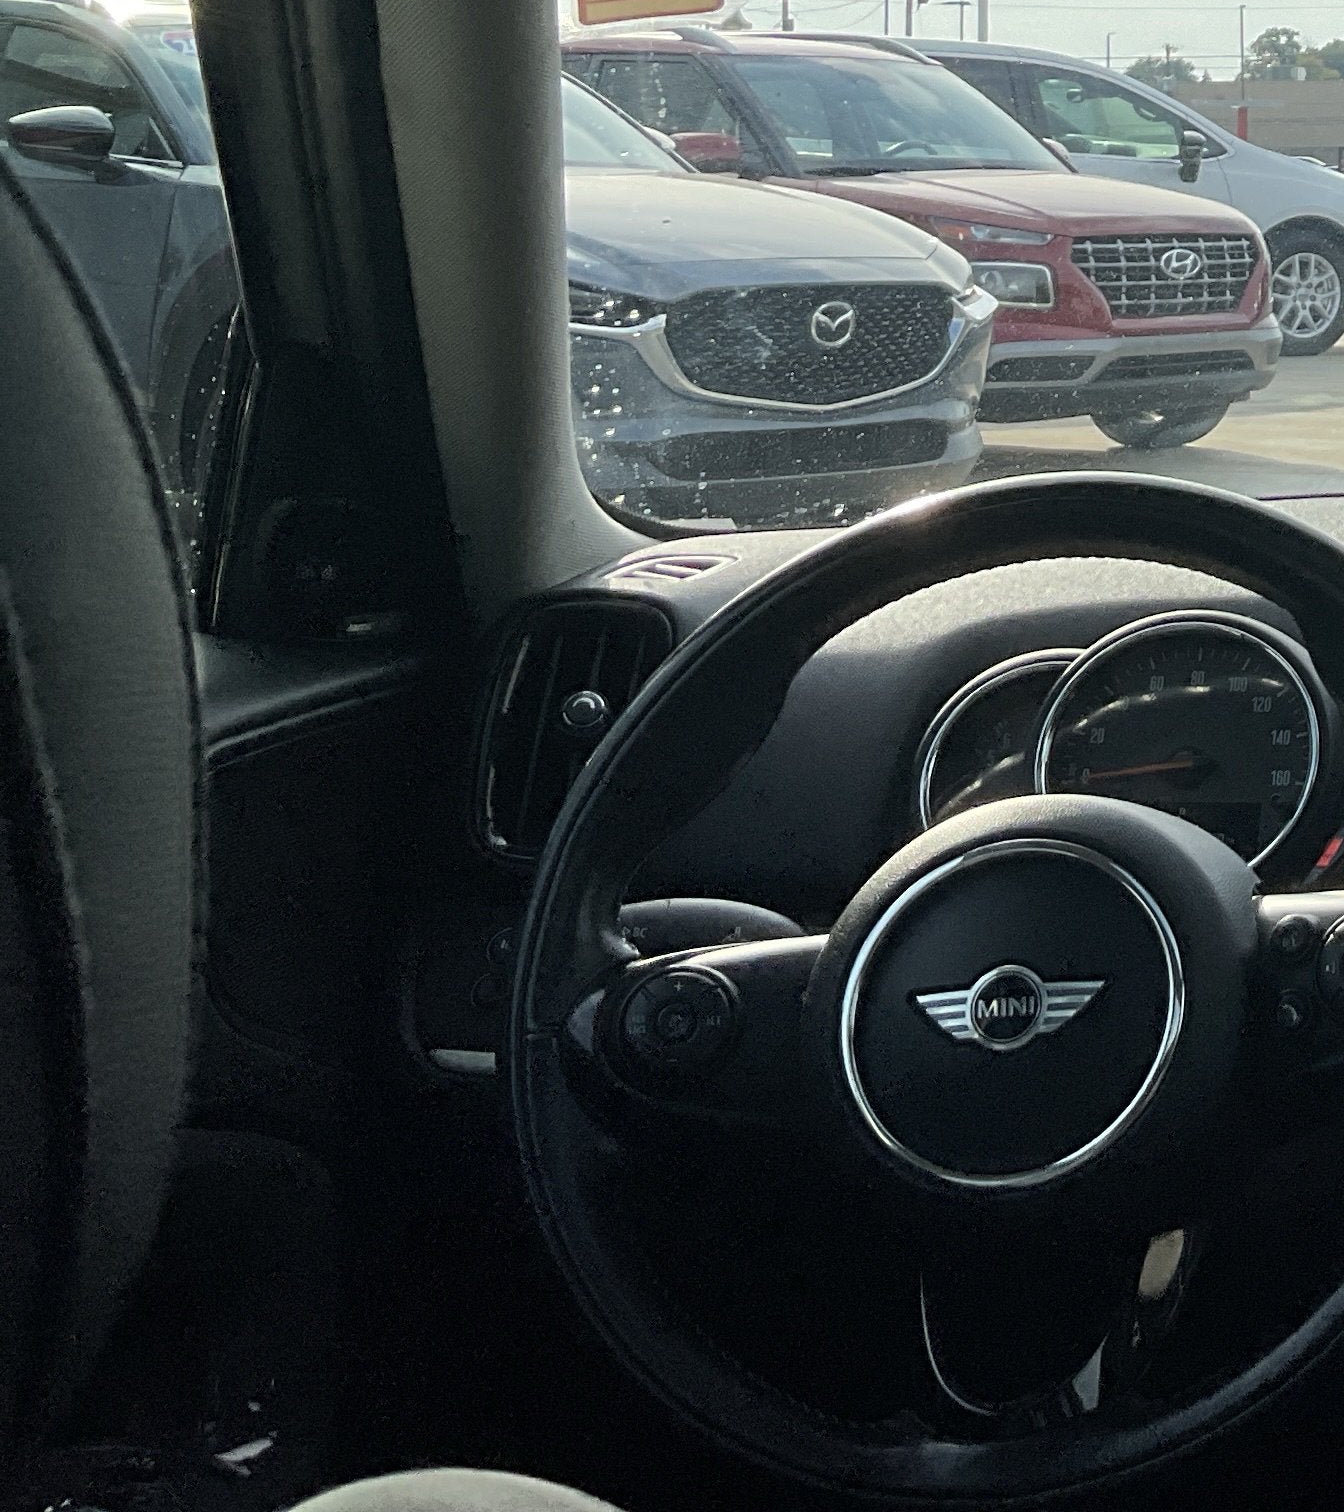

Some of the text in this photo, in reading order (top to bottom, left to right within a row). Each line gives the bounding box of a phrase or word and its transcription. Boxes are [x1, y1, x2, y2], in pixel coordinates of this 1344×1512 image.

[1150, 675, 1165, 691] 60
[1228, 676, 1248, 692] 100
[1252, 696, 1272, 712] 120
[1090, 727, 1105, 744] 20
[1271, 729, 1291, 746] 140
[1271, 770, 1291, 786] 160
[976, 995, 1036, 1019] MINI
